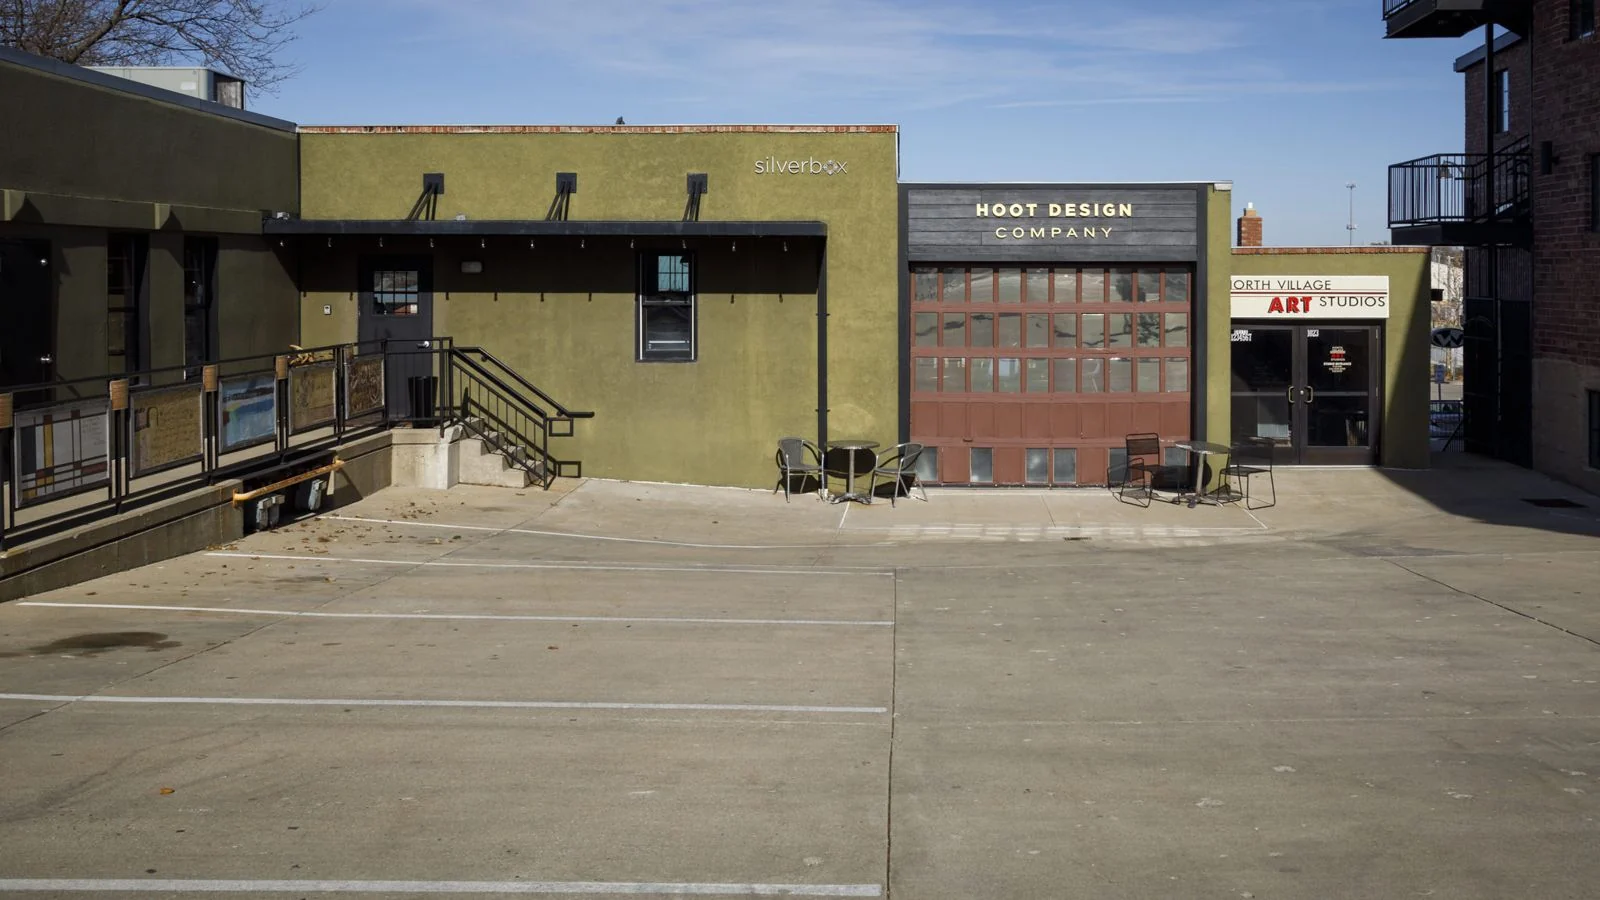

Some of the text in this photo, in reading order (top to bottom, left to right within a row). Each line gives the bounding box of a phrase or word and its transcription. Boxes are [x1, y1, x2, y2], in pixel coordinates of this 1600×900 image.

[754, 156, 848, 175] silverbox
[976, 203, 1133, 218] HOOT DESIGN
[995, 227, 1113, 240] COMPANY
[1230, 279, 1332, 291] ORTH VILLAGE
[1267, 296, 1386, 314] ART STUDIOS
